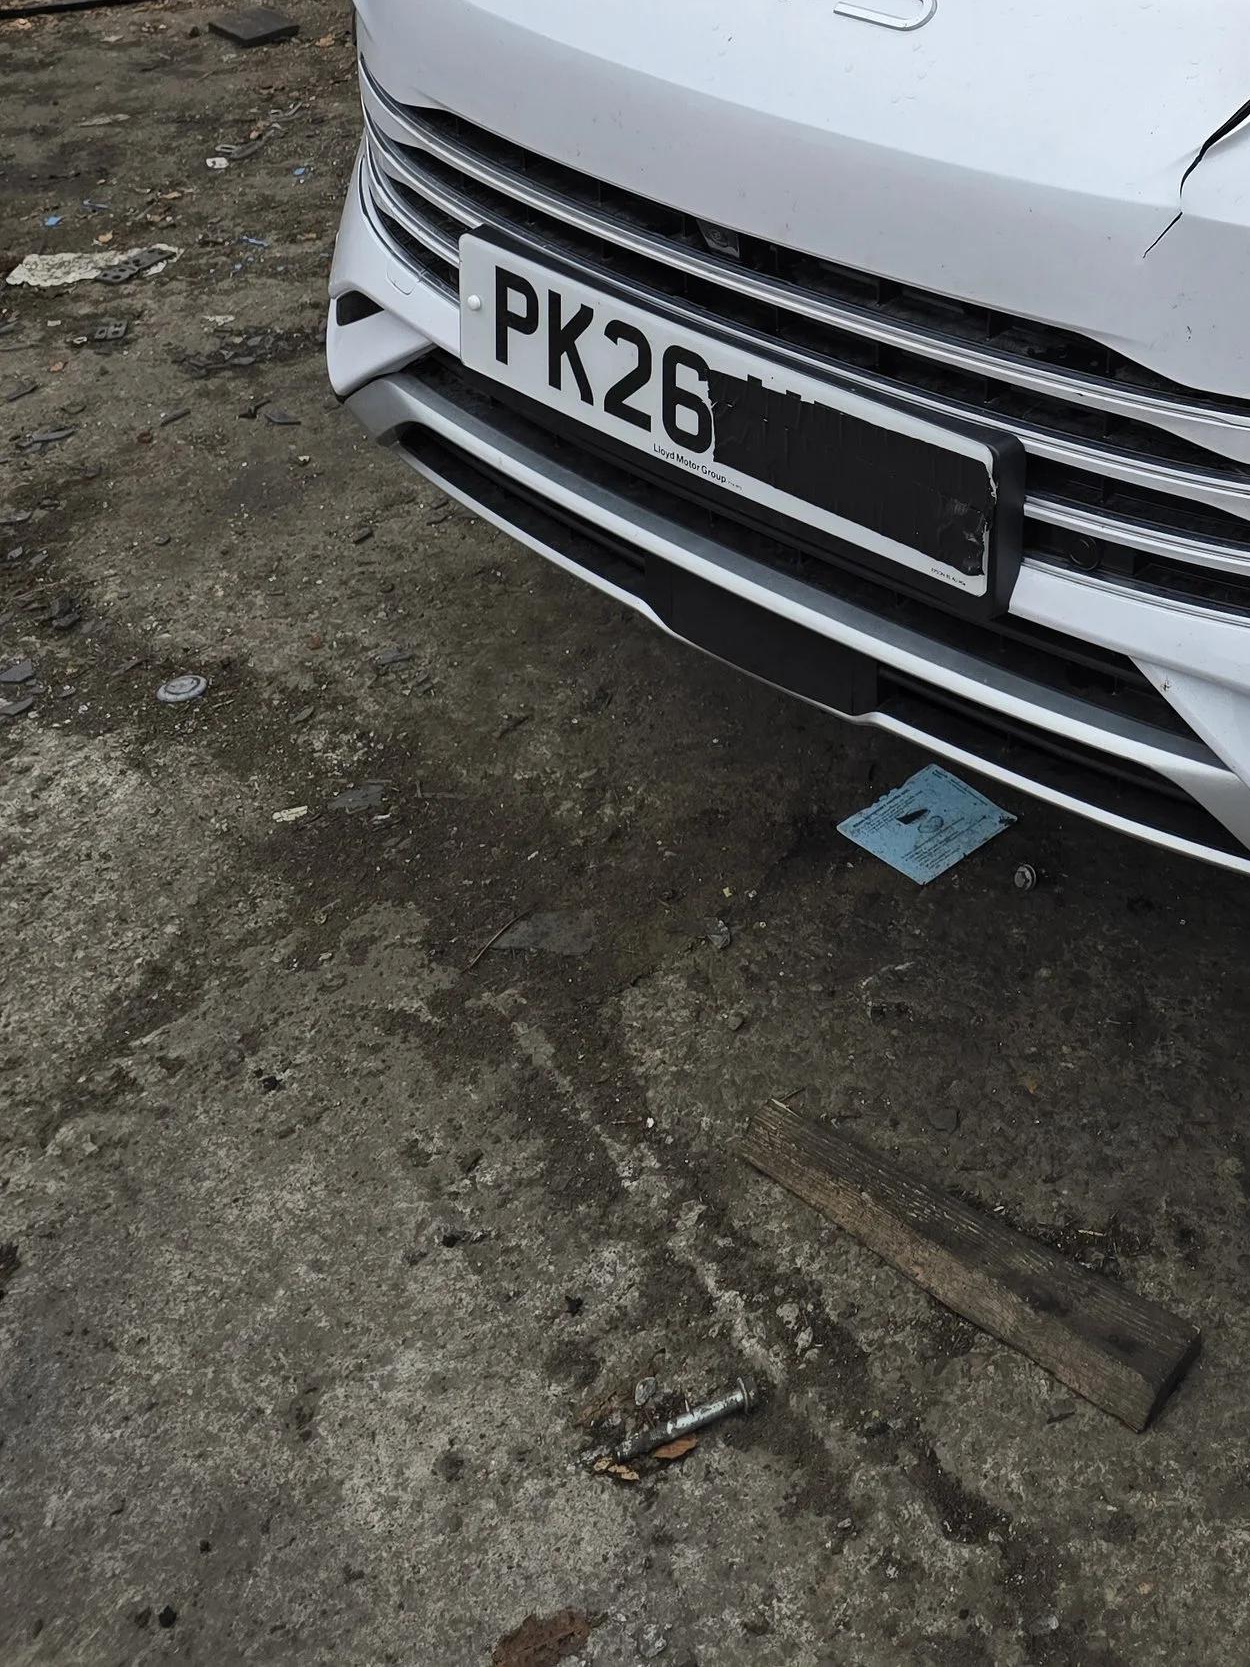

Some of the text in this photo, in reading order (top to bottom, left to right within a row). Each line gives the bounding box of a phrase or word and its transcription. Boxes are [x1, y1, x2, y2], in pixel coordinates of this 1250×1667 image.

[495, 265, 713, 454] PK26
[653, 442, 727, 483] Lloyd Motor Group
